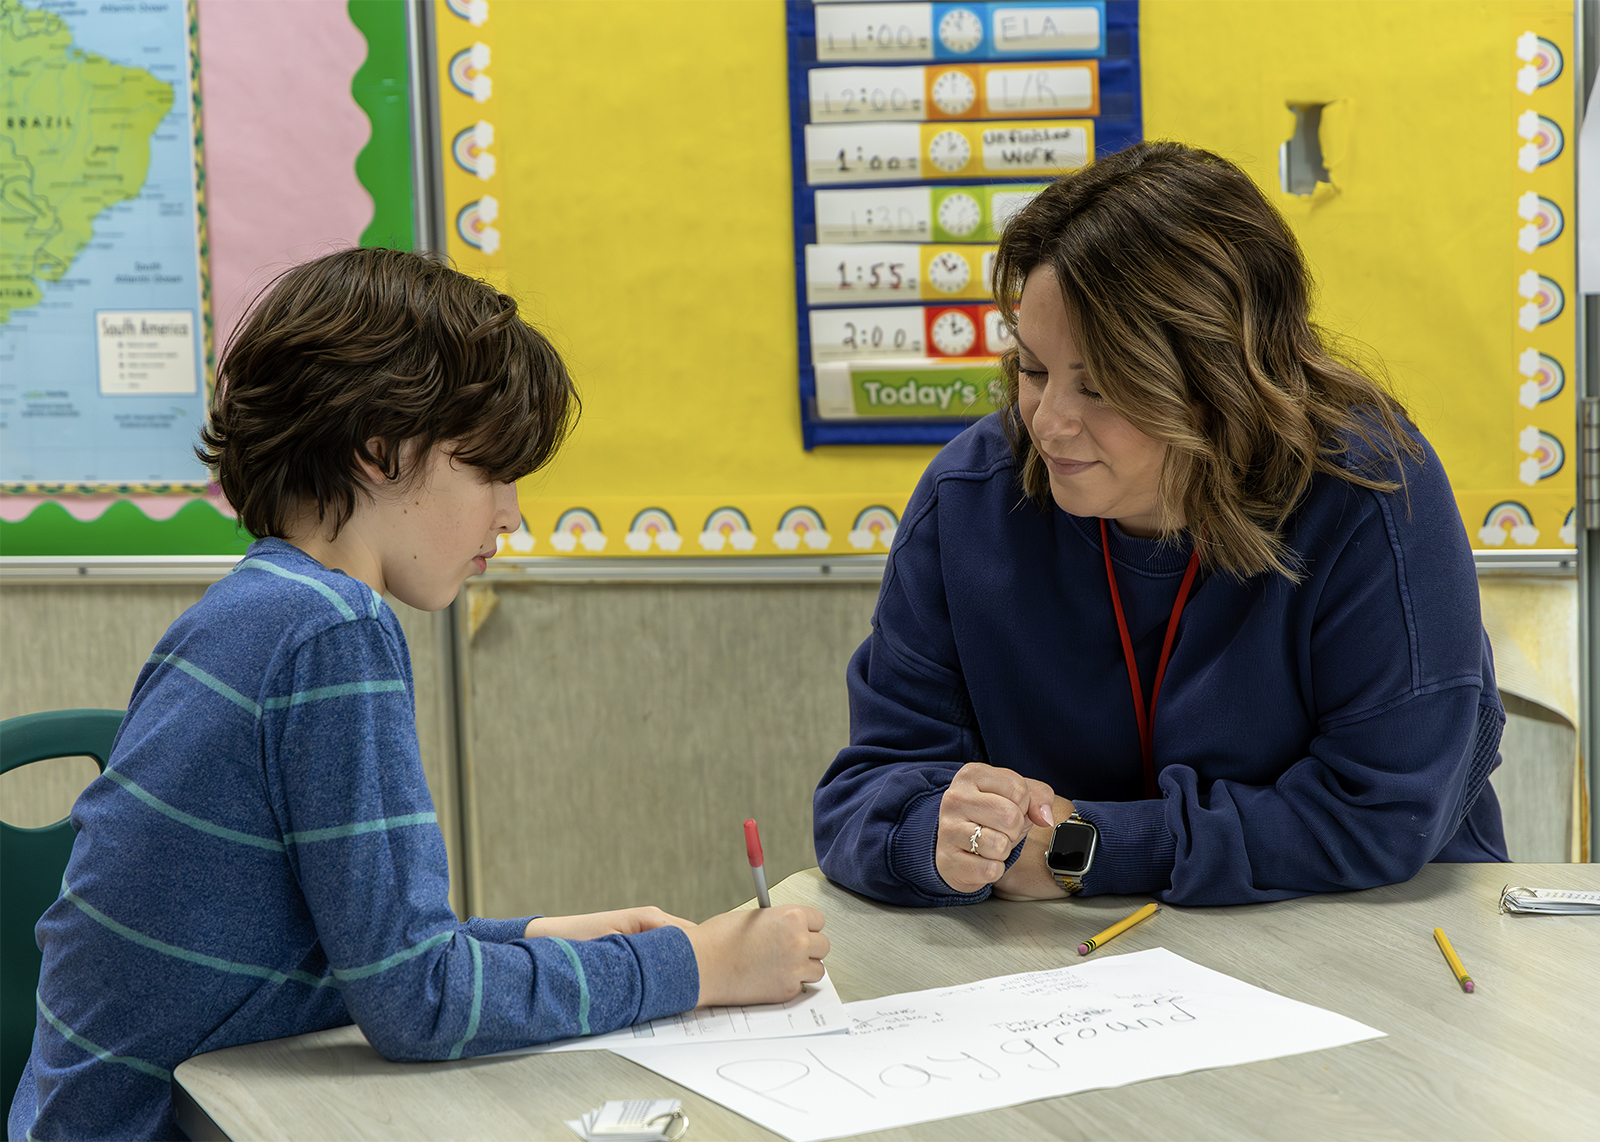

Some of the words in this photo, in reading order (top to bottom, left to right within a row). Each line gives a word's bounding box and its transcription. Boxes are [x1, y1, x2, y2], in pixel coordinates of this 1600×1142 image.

[827, 24, 913, 51] 11:00
[1001, 16, 1065, 41] ELA
[824, 87, 908, 112] 12:00
[1002, 71, 1058, 108] L/R
[7, 116, 72, 129] BRAZIL
[836, 147, 900, 171] 1:00
[850, 205, 914, 237] 1:30
[838, 260, 904, 290] 1:55
[102, 318, 136, 335] South
[141, 318, 188, 335] America
[843, 322, 906, 349] 2:00
[864, 379, 978, 411] Today's
[716, 998, 1196, 1114] Playground
